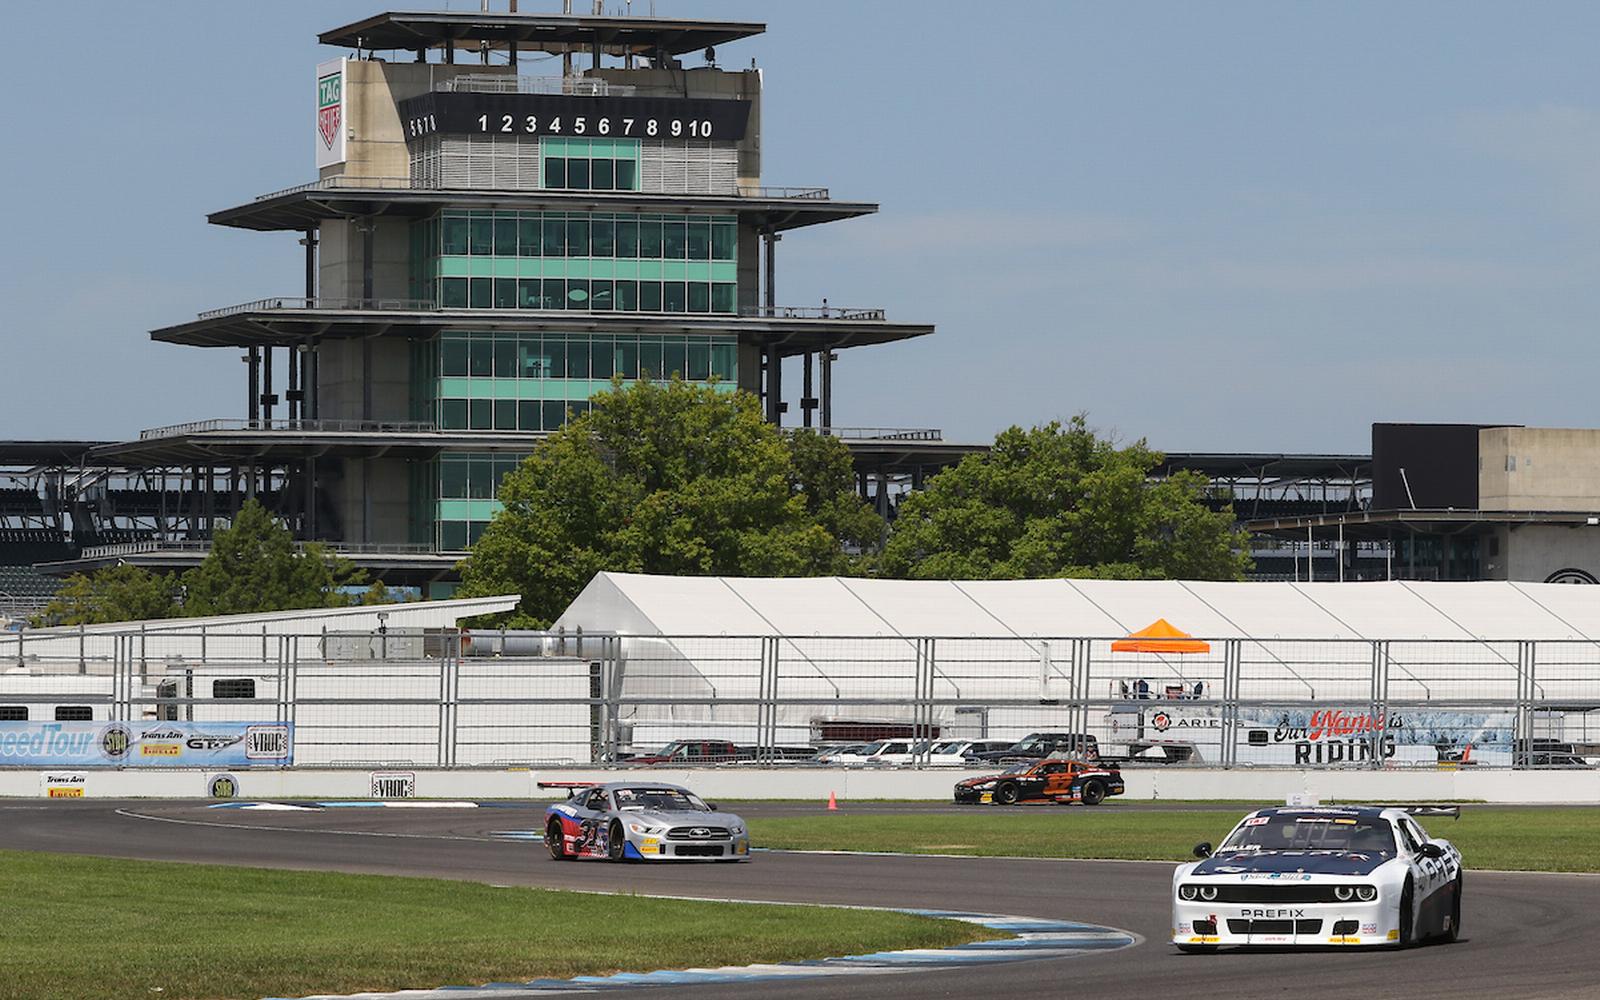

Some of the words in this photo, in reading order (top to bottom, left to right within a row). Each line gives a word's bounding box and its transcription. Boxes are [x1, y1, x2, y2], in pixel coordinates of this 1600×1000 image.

[320, 81, 341, 105] TAG
[410, 120, 416, 137] 5
[478, 114, 487, 132] 1
[501, 115, 513, 132] 2
[525, 115, 537, 133] 3
[549, 116, 562, 133] 4
[574, 117, 586, 134] 5
[598, 117, 610, 135] 6
[623, 118, 634, 136] 7
[646, 119, 658, 136] 8
[671, 119, 682, 137] 9
[688, 120, 712, 138] 10
[141, 731, 165, 740] Trans
[166, 731, 183, 740] Am
[1309, 710, 1385, 741] Name
[1388, 712, 1403, 728] is
[0, 723, 95, 757] eedTour
[1295, 734, 1396, 764] RIDING
[1222, 844, 1261, 852] MILLER
[1241, 909, 1304, 918] PREFIX
